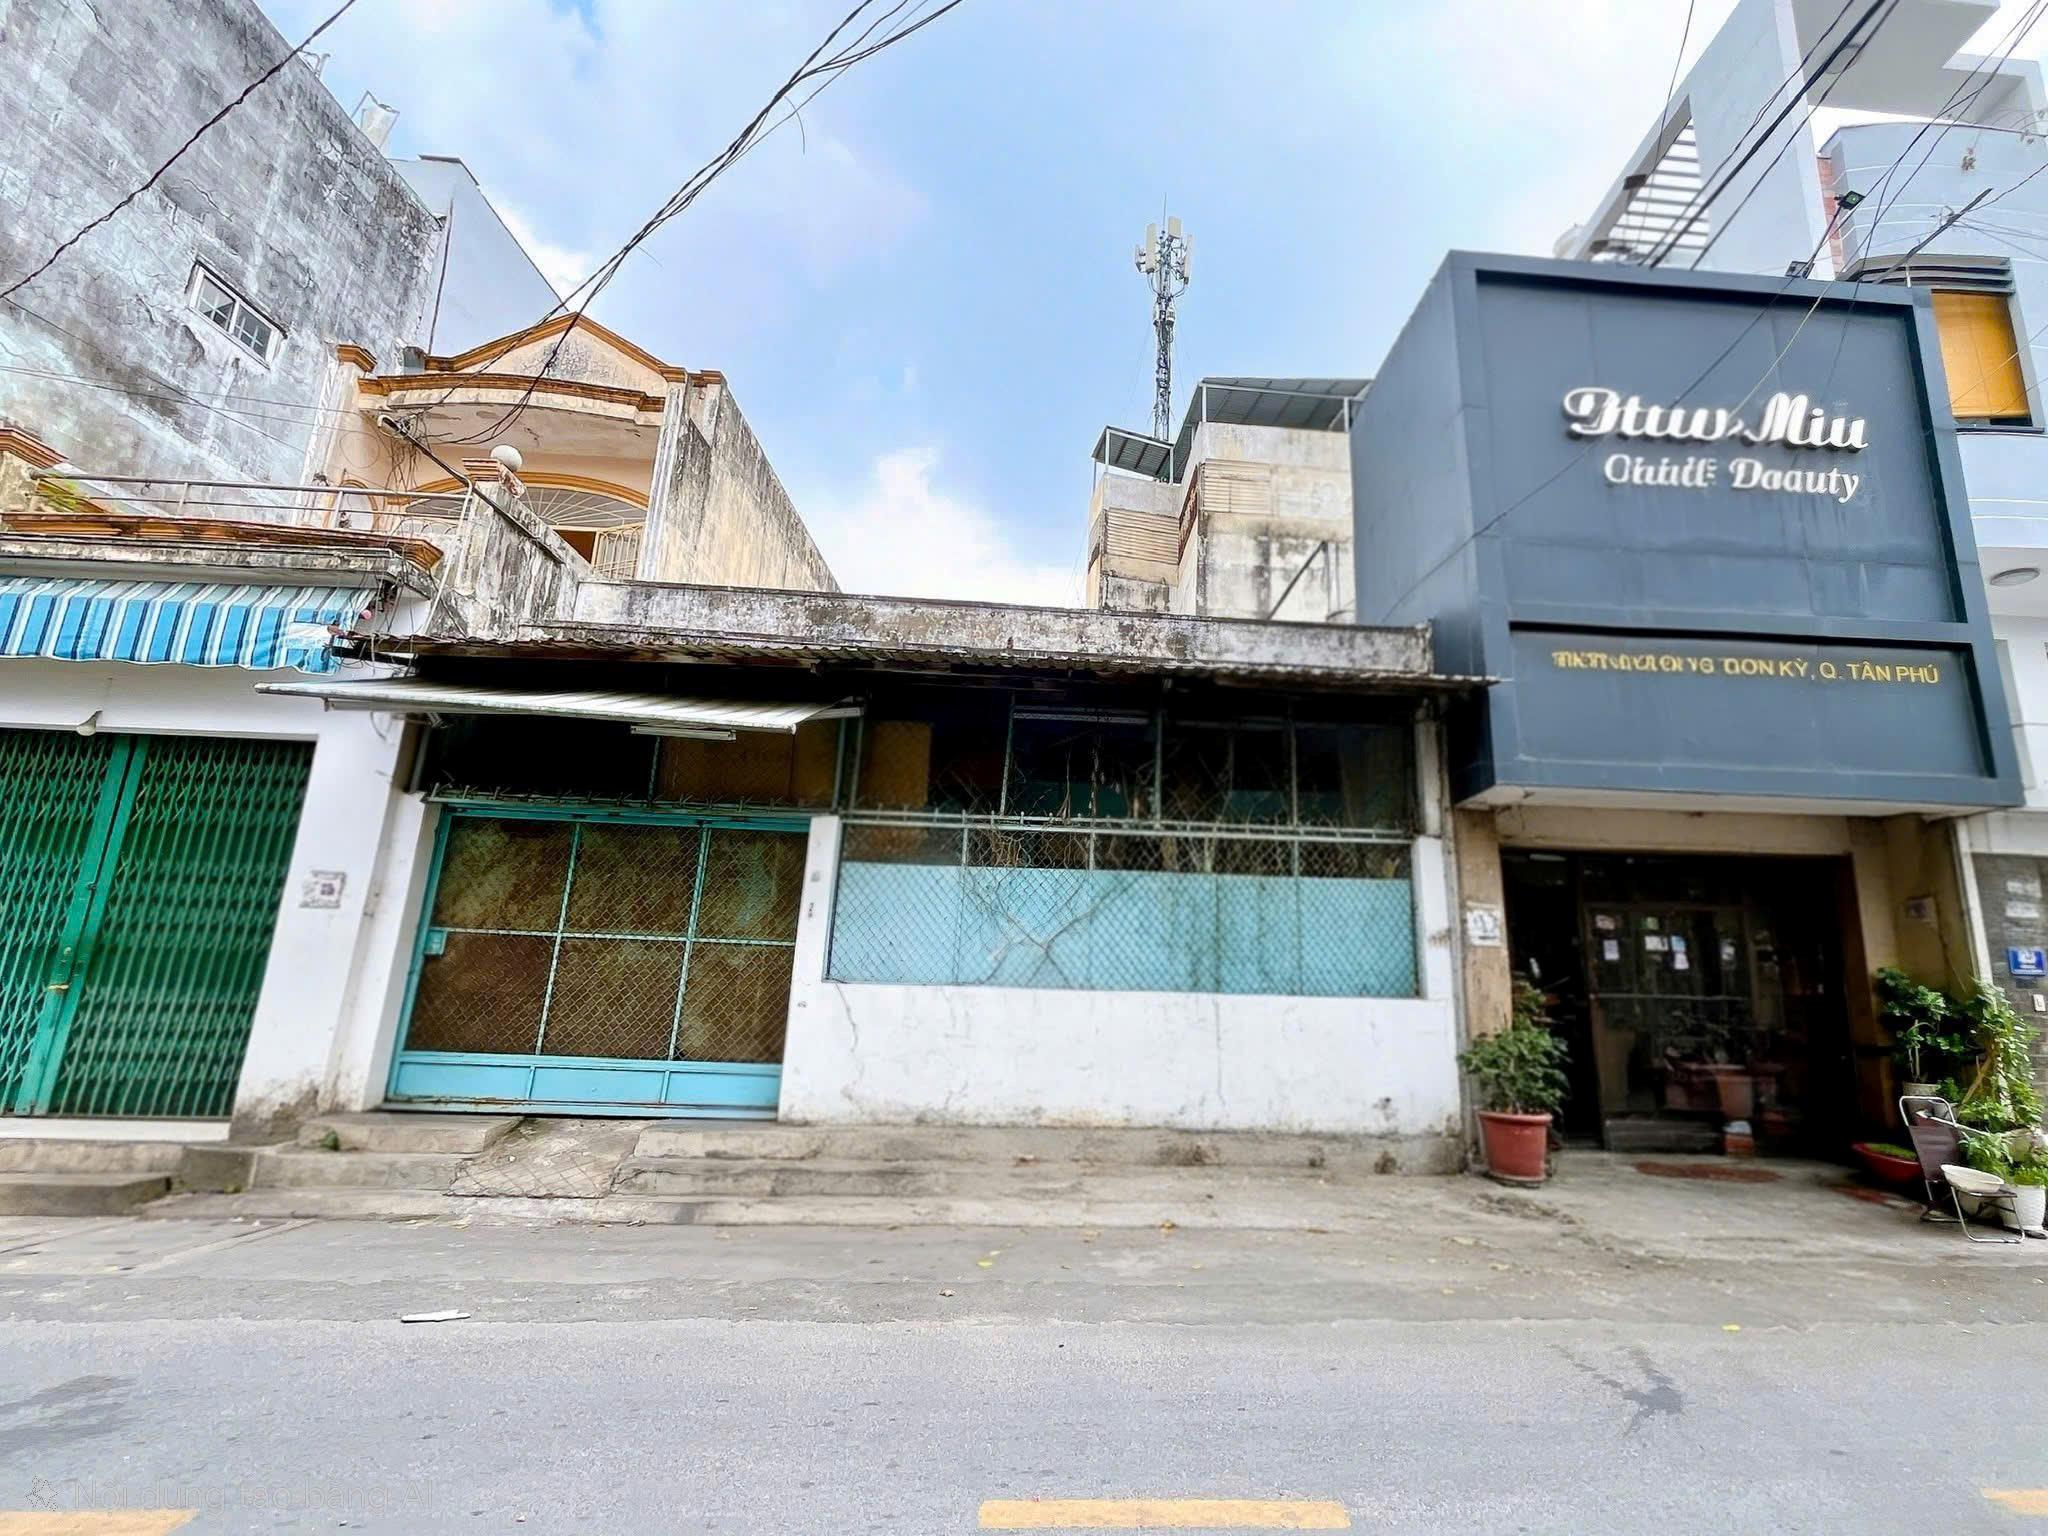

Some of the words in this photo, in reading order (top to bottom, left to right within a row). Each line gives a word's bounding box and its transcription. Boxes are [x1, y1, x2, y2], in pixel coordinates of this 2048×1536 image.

[1743, 392, 1869, 449] Miu
[1819, 661, 1844, 680] Q.
[1846, 660, 1891, 682] TÂN
[1895, 663, 1939, 684] PHÚ
